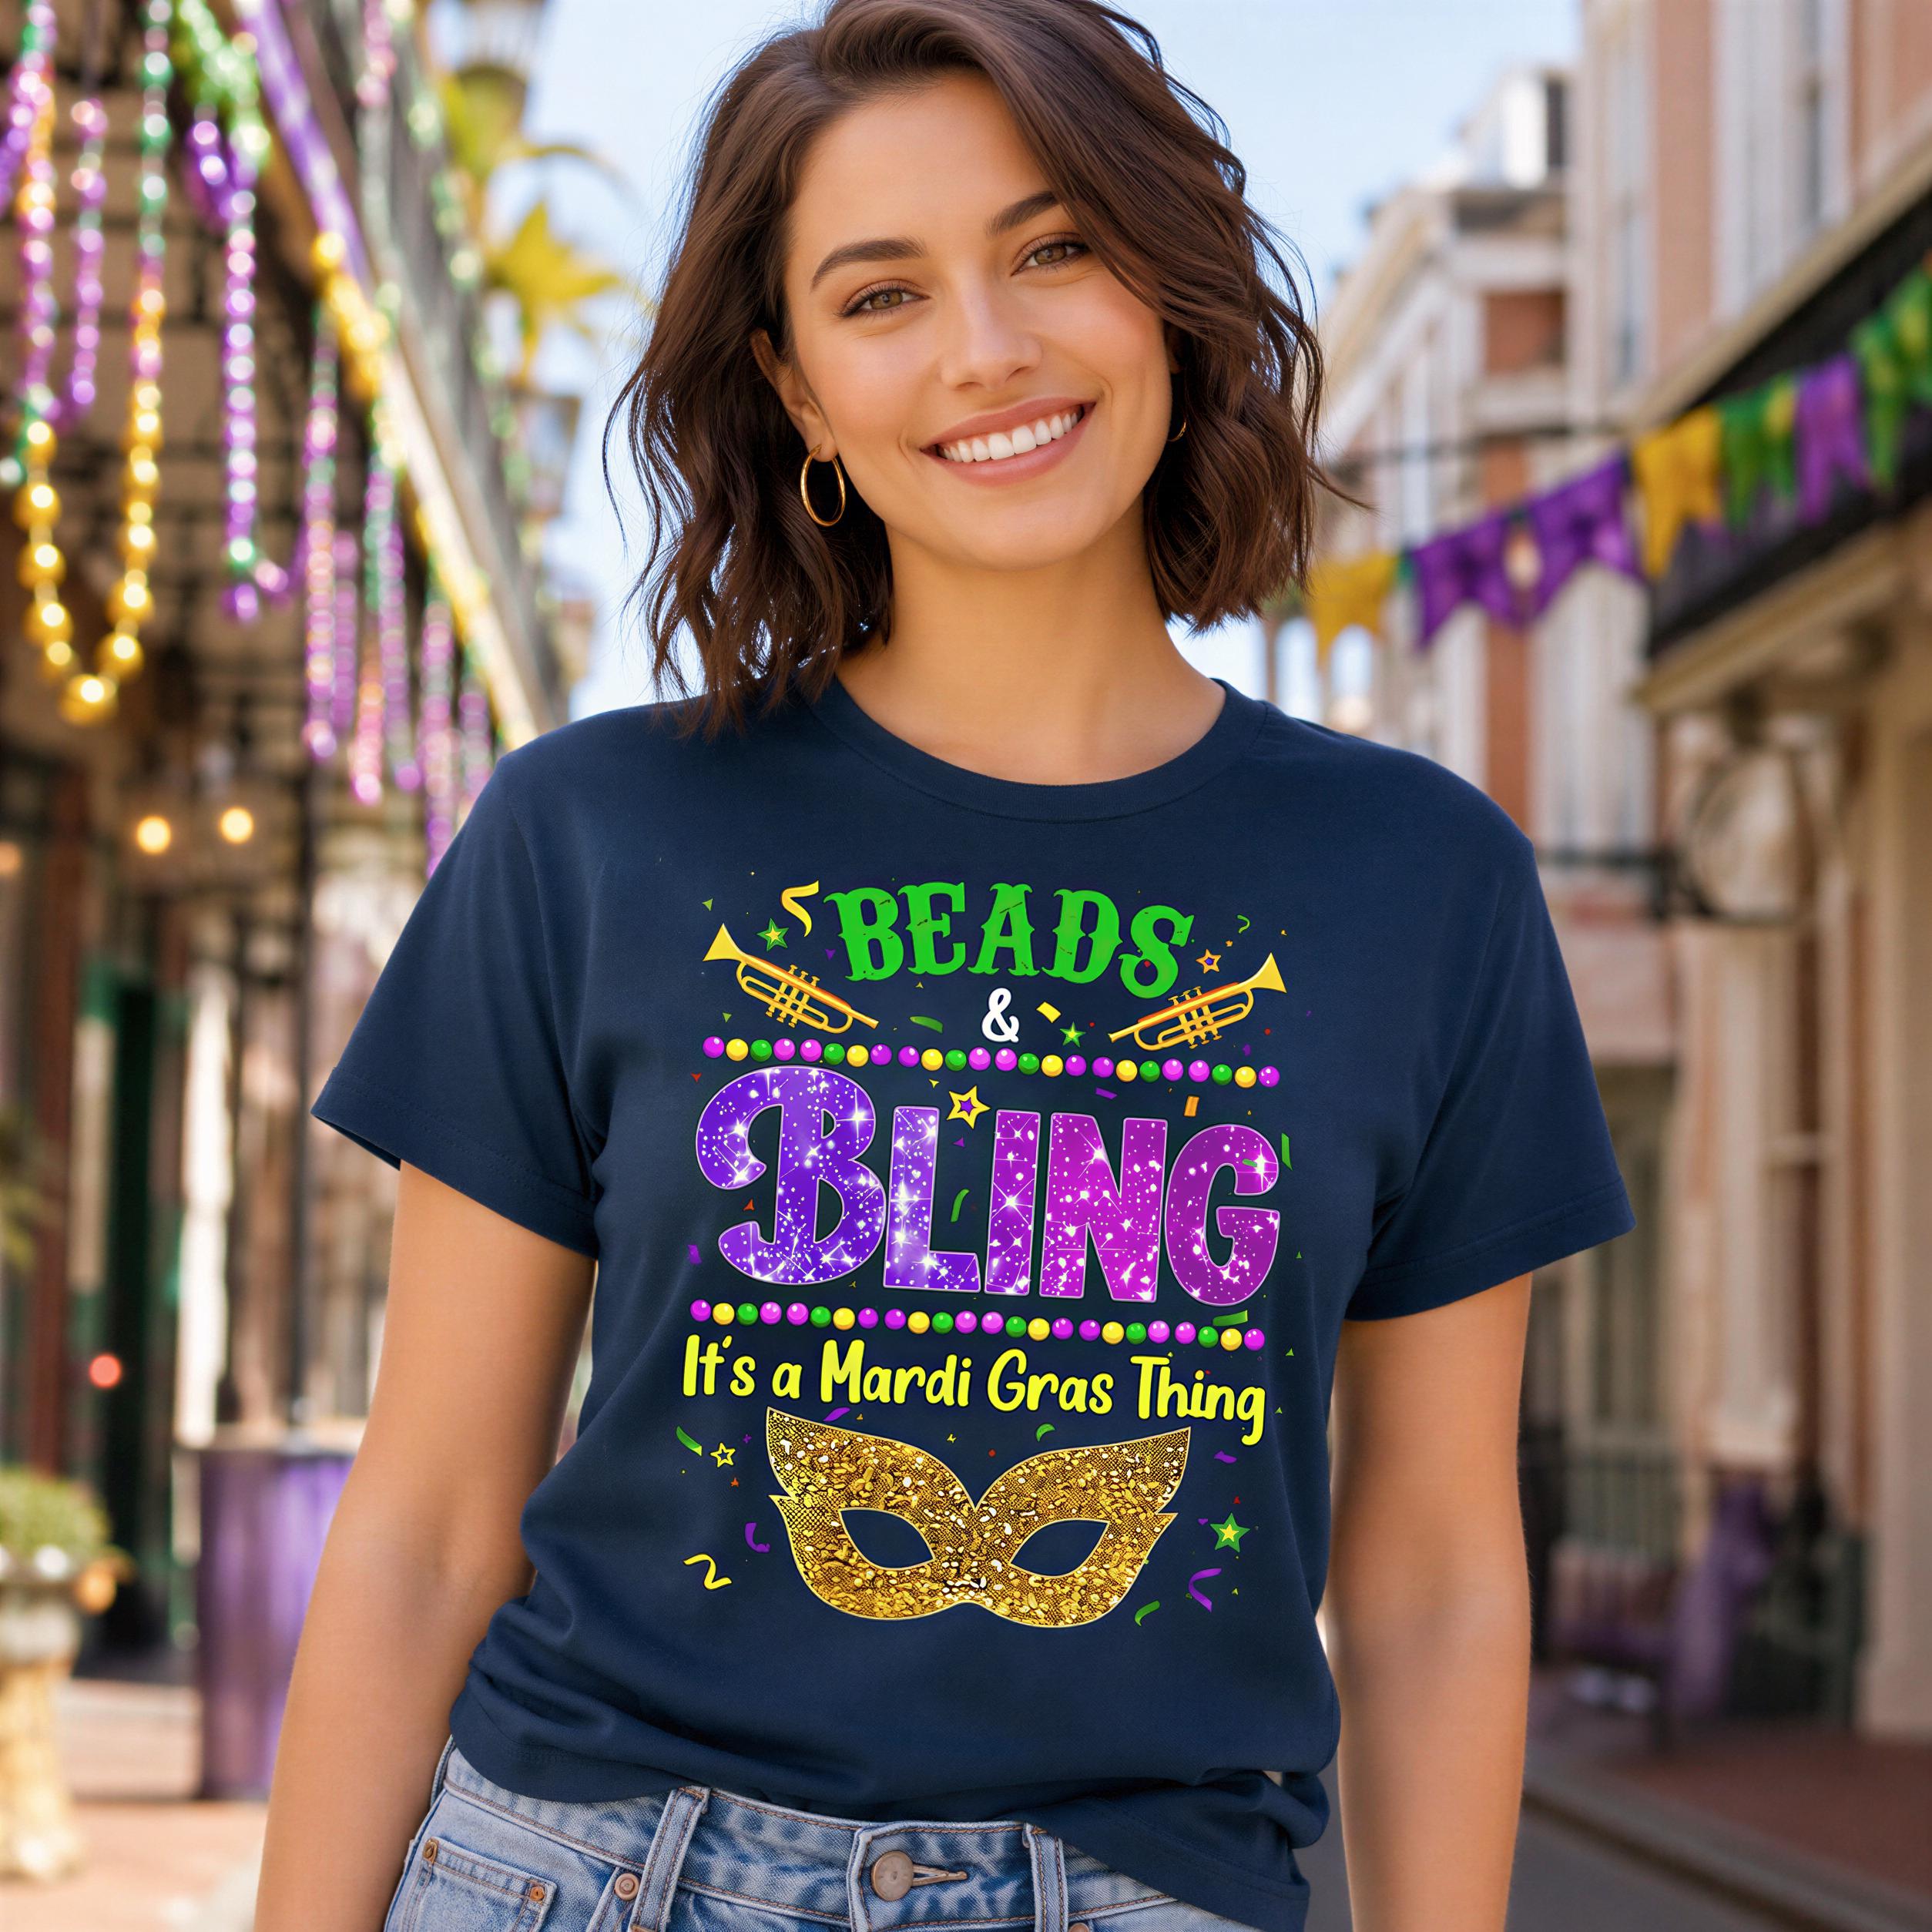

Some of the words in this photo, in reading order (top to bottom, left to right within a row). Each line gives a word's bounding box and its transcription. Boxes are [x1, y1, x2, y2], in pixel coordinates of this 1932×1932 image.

[823, 881, 1195, 999] BEADS
[981, 988, 1020, 1043] &
[696, 1065, 1280, 1306] BLING
[683, 1334, 757, 1397] It's
[772, 1361, 801, 1399] a
[820, 1340, 972, 1408] Mardi
[988, 1348, 1114, 1415] Gras
[1130, 1355, 1267, 1445] Thing
